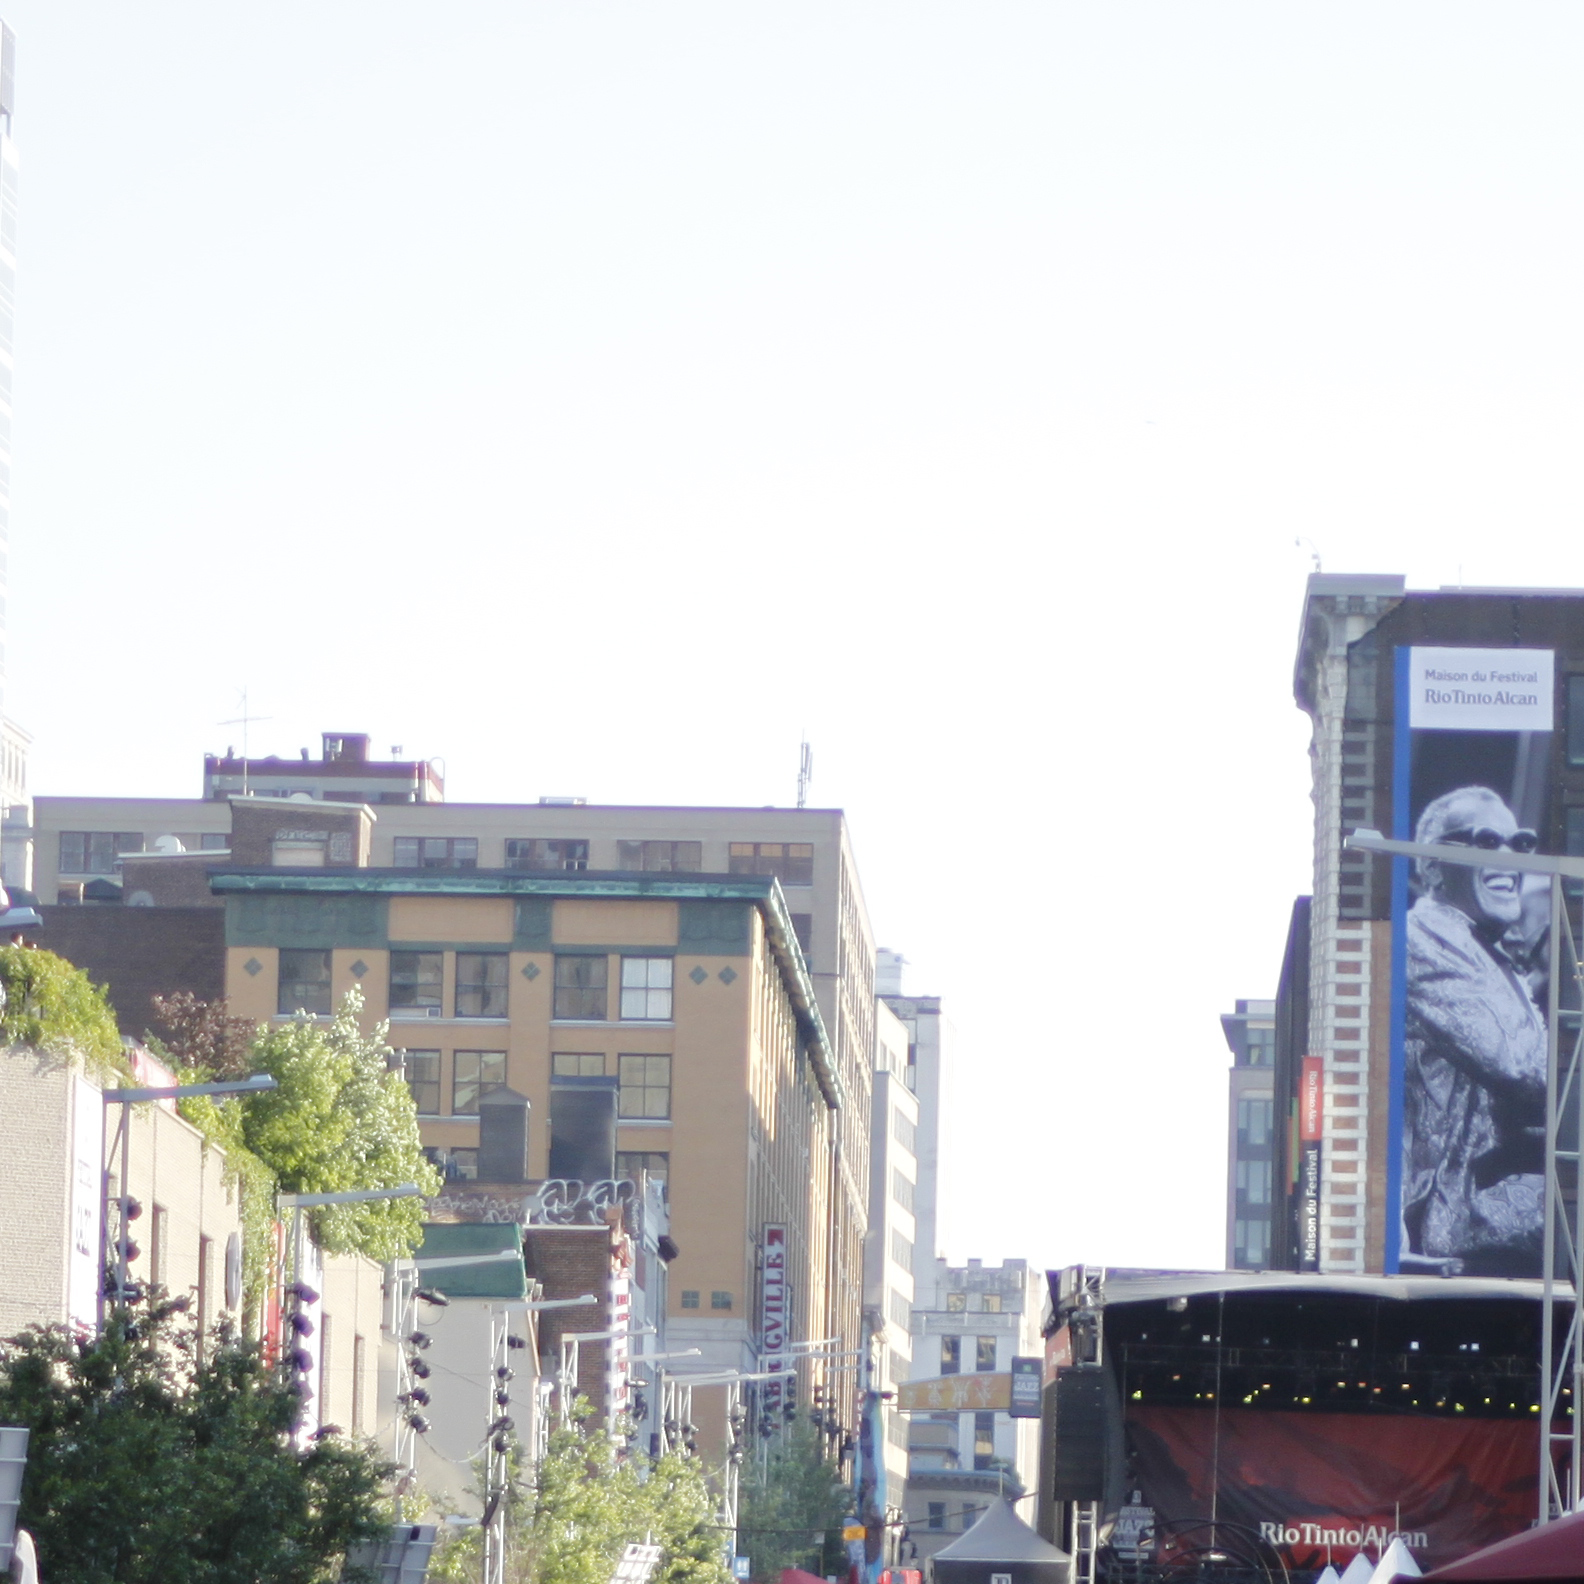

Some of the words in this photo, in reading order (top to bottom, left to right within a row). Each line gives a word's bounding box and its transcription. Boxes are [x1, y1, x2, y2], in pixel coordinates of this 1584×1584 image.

[1425, 669, 1468, 681] Maison
[1471, 671, 1487, 682] du
[1490, 671, 1537, 683] Festival
[1306, 1149, 1318, 1197] Festival
[1306, 1199, 1317, 1213] du
[1305, 1214, 1316, 1261] Maison
